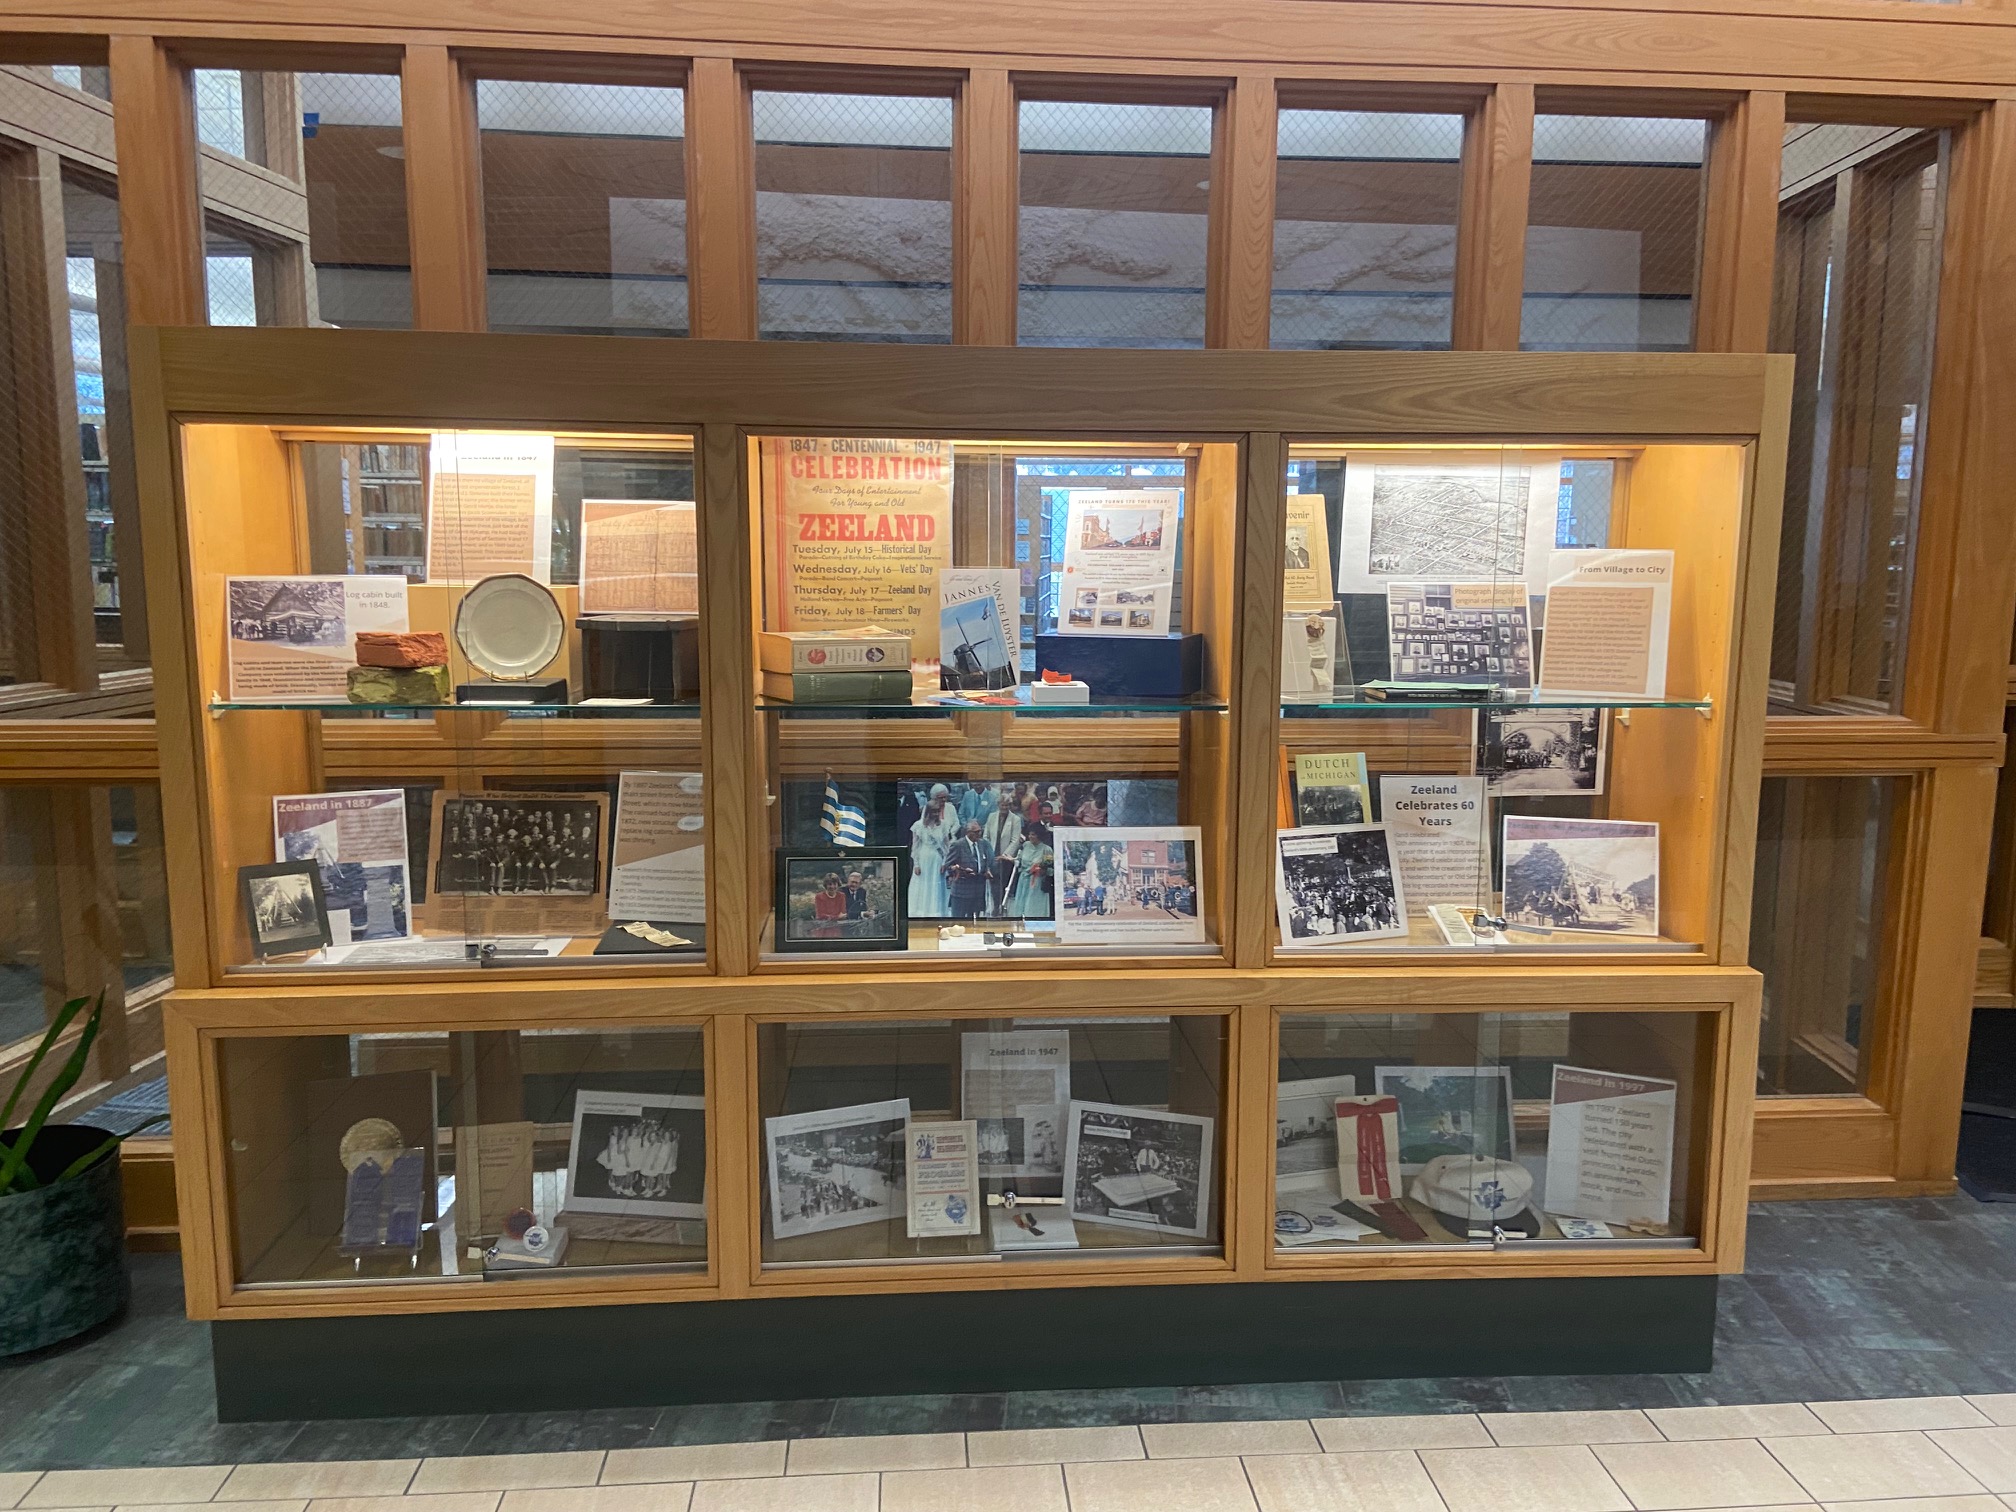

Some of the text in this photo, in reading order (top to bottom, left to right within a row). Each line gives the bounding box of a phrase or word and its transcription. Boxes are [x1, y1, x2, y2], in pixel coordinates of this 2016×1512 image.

[790, 439, 941, 454] 1847 CENTENNIAL 1947
[790, 455, 941, 480] CELEBRATION
[812, 486, 922, 497] Four Days of Entertainment
[830, 498, 905, 509] For Young and Old
[1286, 511, 1310, 519] venir
[798, 513, 936, 542] ZEELAND
[792, 544, 840, 555] Tuesday,
[844, 546, 862, 556] July
[918, 545, 932, 556] Day
[793, 564, 861, 575] Wednesday,
[864, 566, 880, 576] July
[920, 564, 933, 576] Day
[1604, 566, 1634, 574] Village
[1647, 566, 1666, 574] City
[346, 592, 360, 600] Log
[794, 586, 847, 596] Thursday,
[850, 587, 867, 596] July
[918, 586, 932, 596] Day
[1455, 588, 1492, 596] Photograph
[1494, 588, 1515, 596] display
[794, 606, 831, 616] Friday,
[835, 608, 853, 617] July
[908, 606, 921, 617] Day
[944, 580, 1017, 658] JANNES VAN DE LUYSTER
[1304, 758, 1350, 769] DUTCH
[1306, 772, 1356, 780] MICHIGAN
[1410, 784, 1458, 795] Zeeland
[278, 798, 372, 812] Zeeland in 1887
[1395, 800, 1474, 810] Celebrates 60
[1418, 817, 1452, 826] Years
[988, 1048, 1059, 1056] Zeeland in 1947
[1556, 1072, 1646, 1092] Zeeland in 1997
[1616, 1108, 1650, 1118] Zeeland
